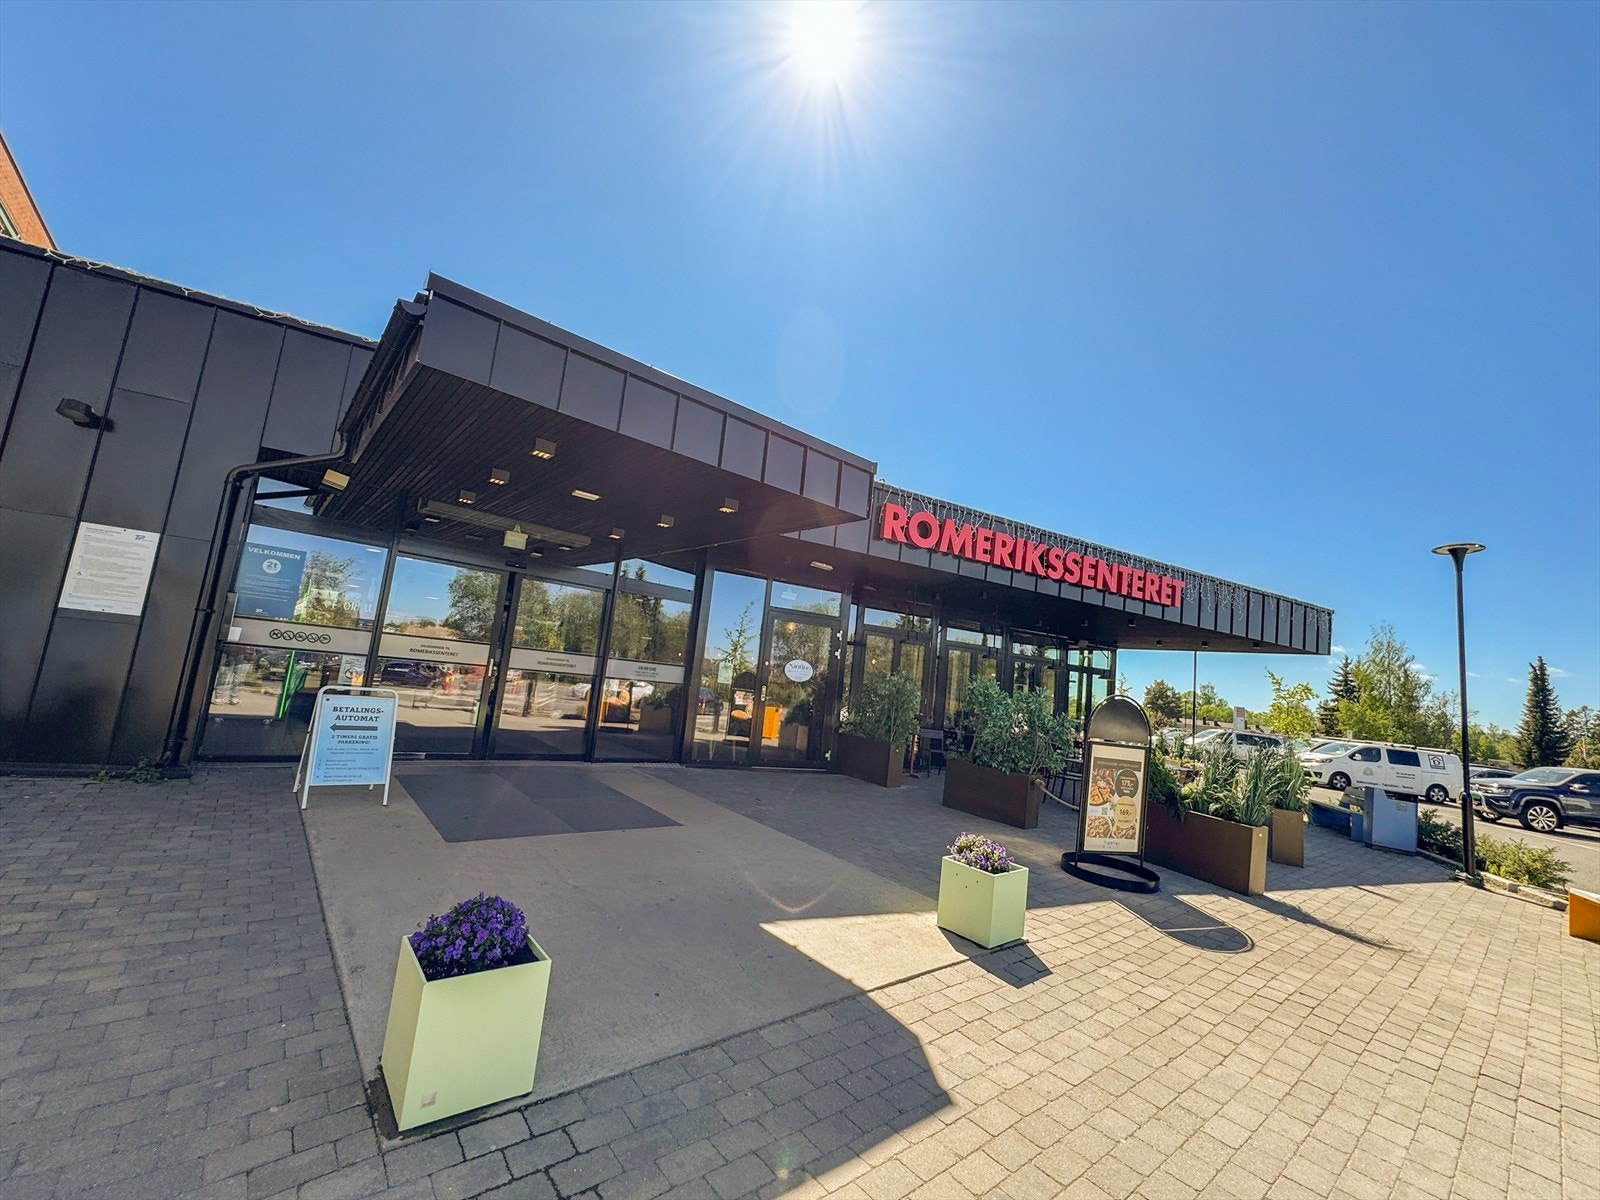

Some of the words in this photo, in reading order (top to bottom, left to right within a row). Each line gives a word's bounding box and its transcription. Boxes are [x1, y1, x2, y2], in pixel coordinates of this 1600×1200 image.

[248, 546, 301, 560] VELKOMMEN
[881, 502, 1184, 608] ROMERIKSSENTERET
[409, 648, 459, 657] ROMERIKSSENTERET
[332, 706, 384, 714] BETALINGS-
[335, 714, 380, 722] AUTOMAT
